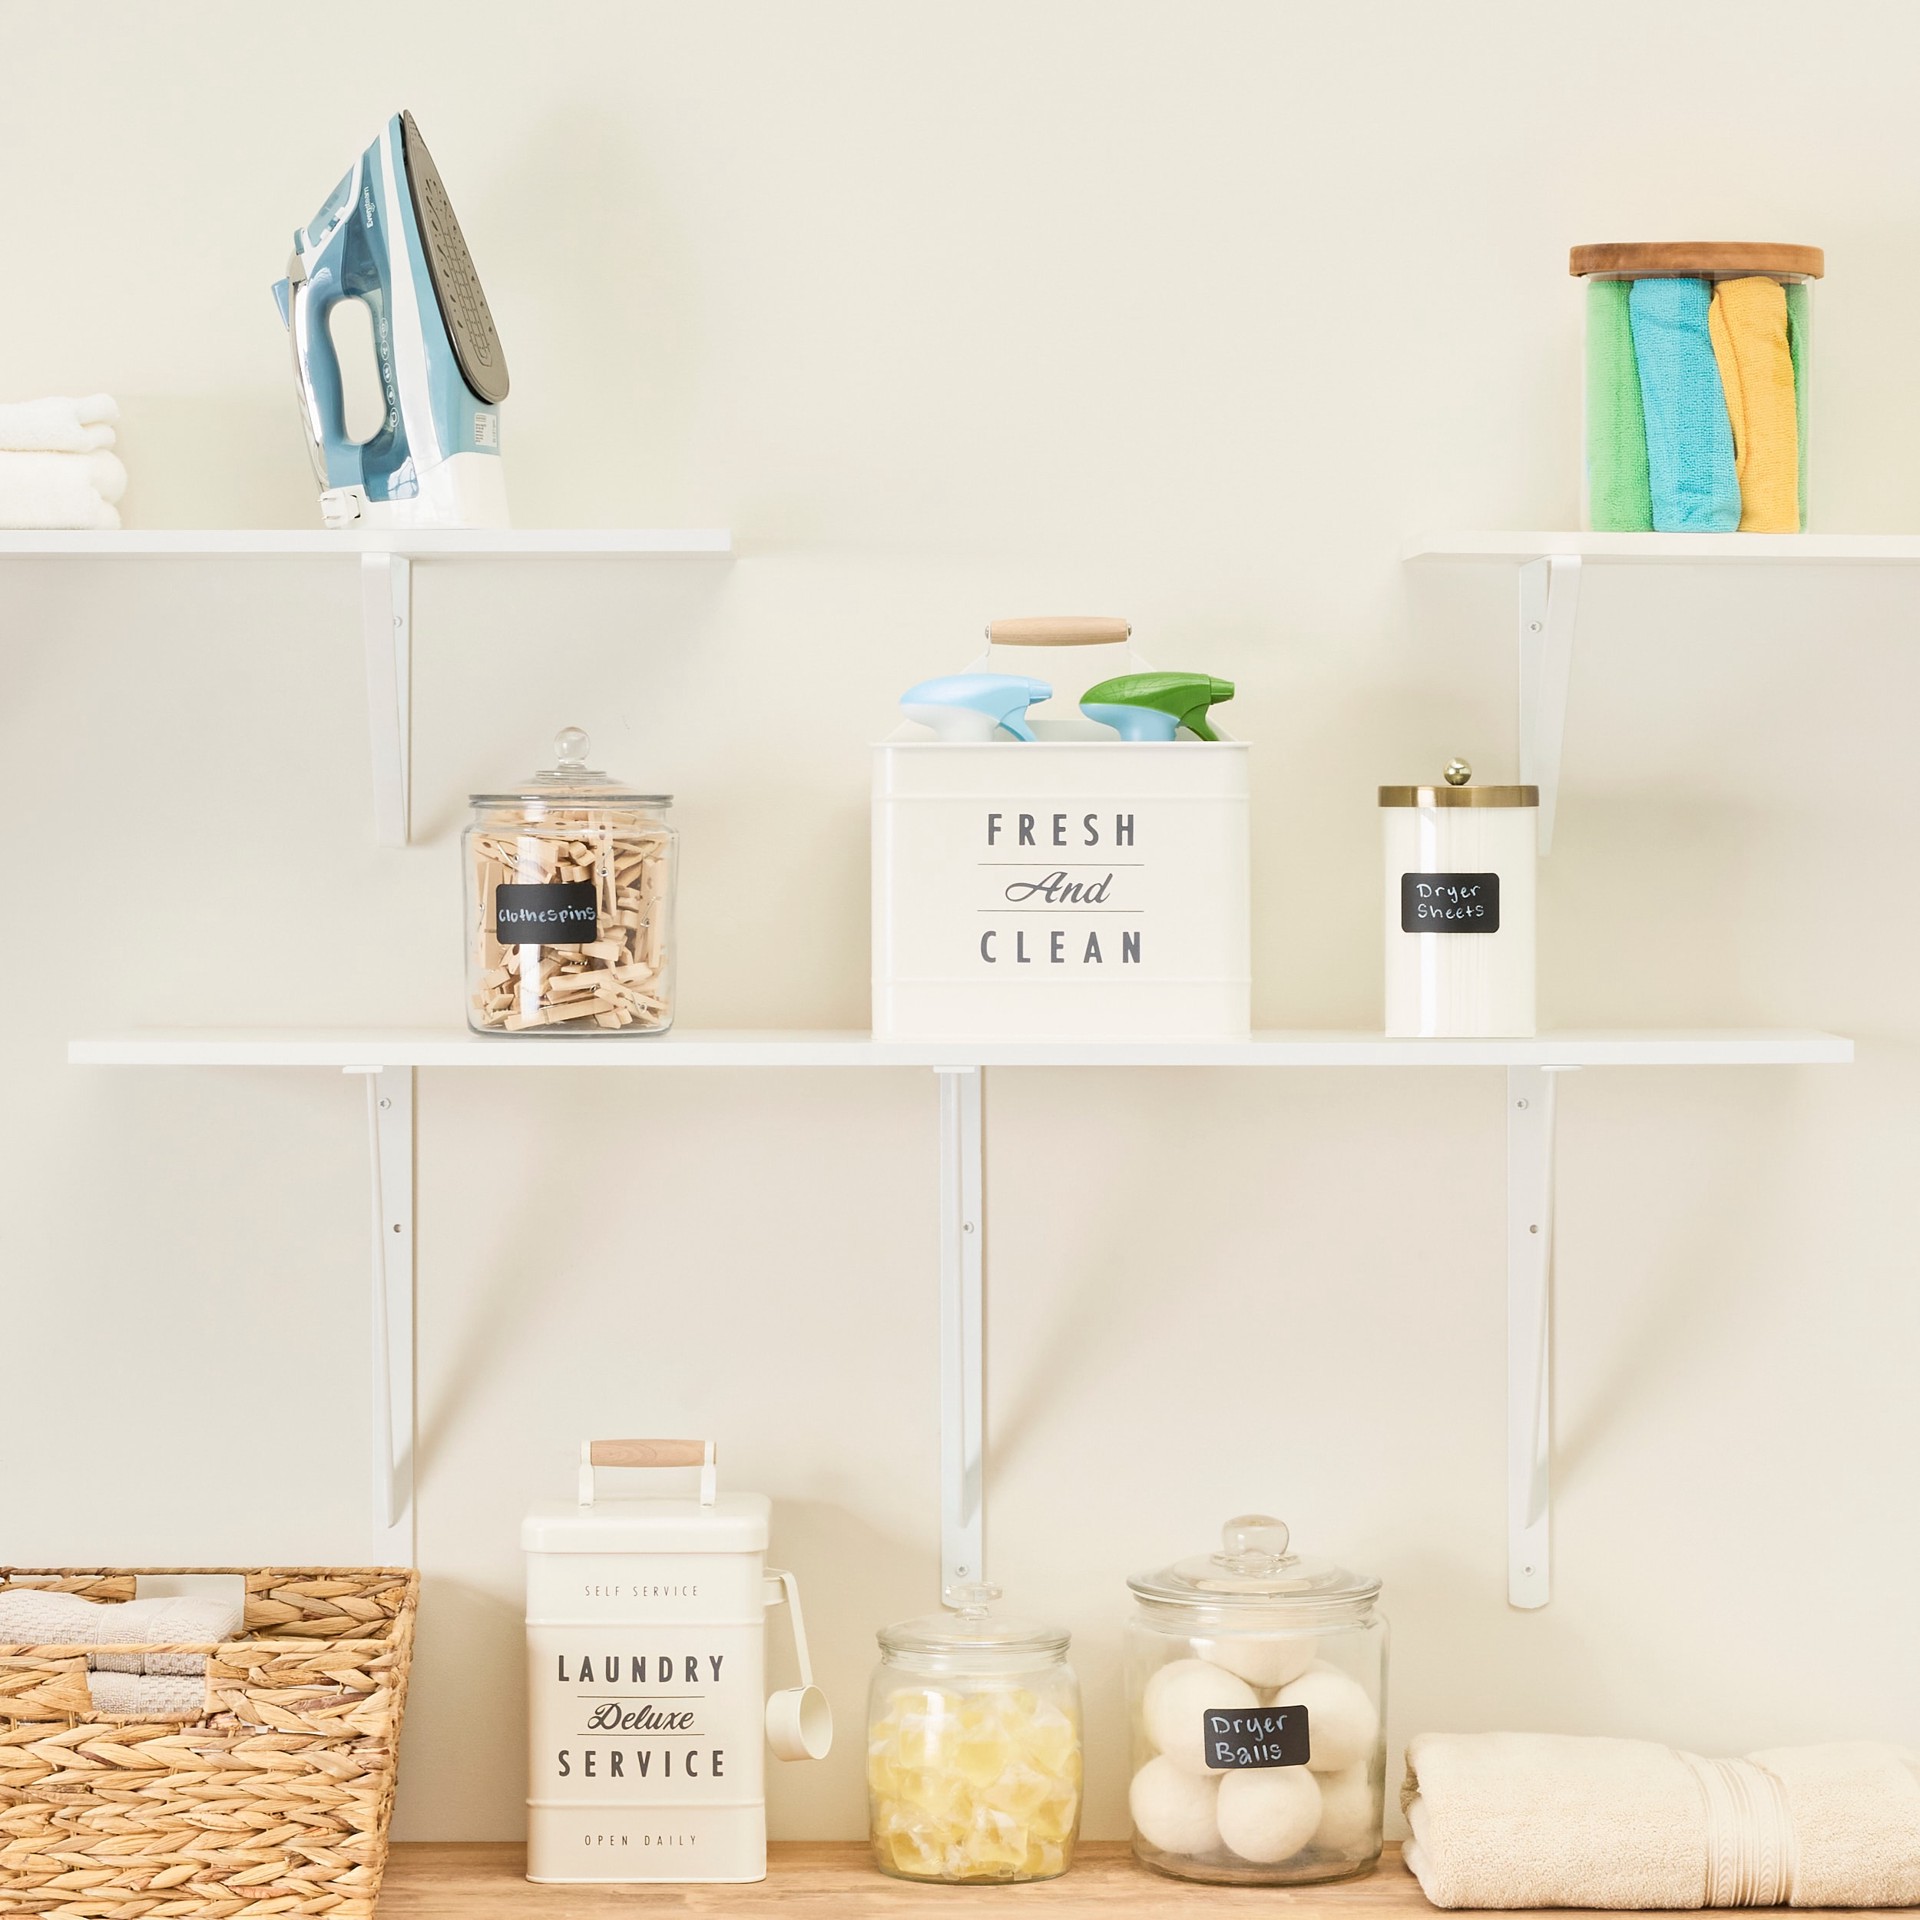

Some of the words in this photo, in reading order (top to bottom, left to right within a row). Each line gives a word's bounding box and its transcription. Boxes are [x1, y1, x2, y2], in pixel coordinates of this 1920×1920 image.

[987, 813, 1135, 847] FRESH
[1004, 871, 1114, 904] And
[1416, 883, 1481, 904] Dryer
[1417, 903, 1484, 919] Sheets
[980, 930, 1141, 964] CLEAN
[585, 1585, 620, 1597] SELF
[632, 1585, 698, 1597] SERVICE
[558, 1654, 724, 1683] LAUNDRY
[587, 1702, 695, 1730] Deluxe
[1210, 1714, 1288, 1742] Dryer
[558, 1750, 724, 1778] SERVICE
[1215, 1741, 1282, 1765] Balls
[584, 1834, 628, 1846] OPEN
[644, 1834, 697, 1846] DAILY
